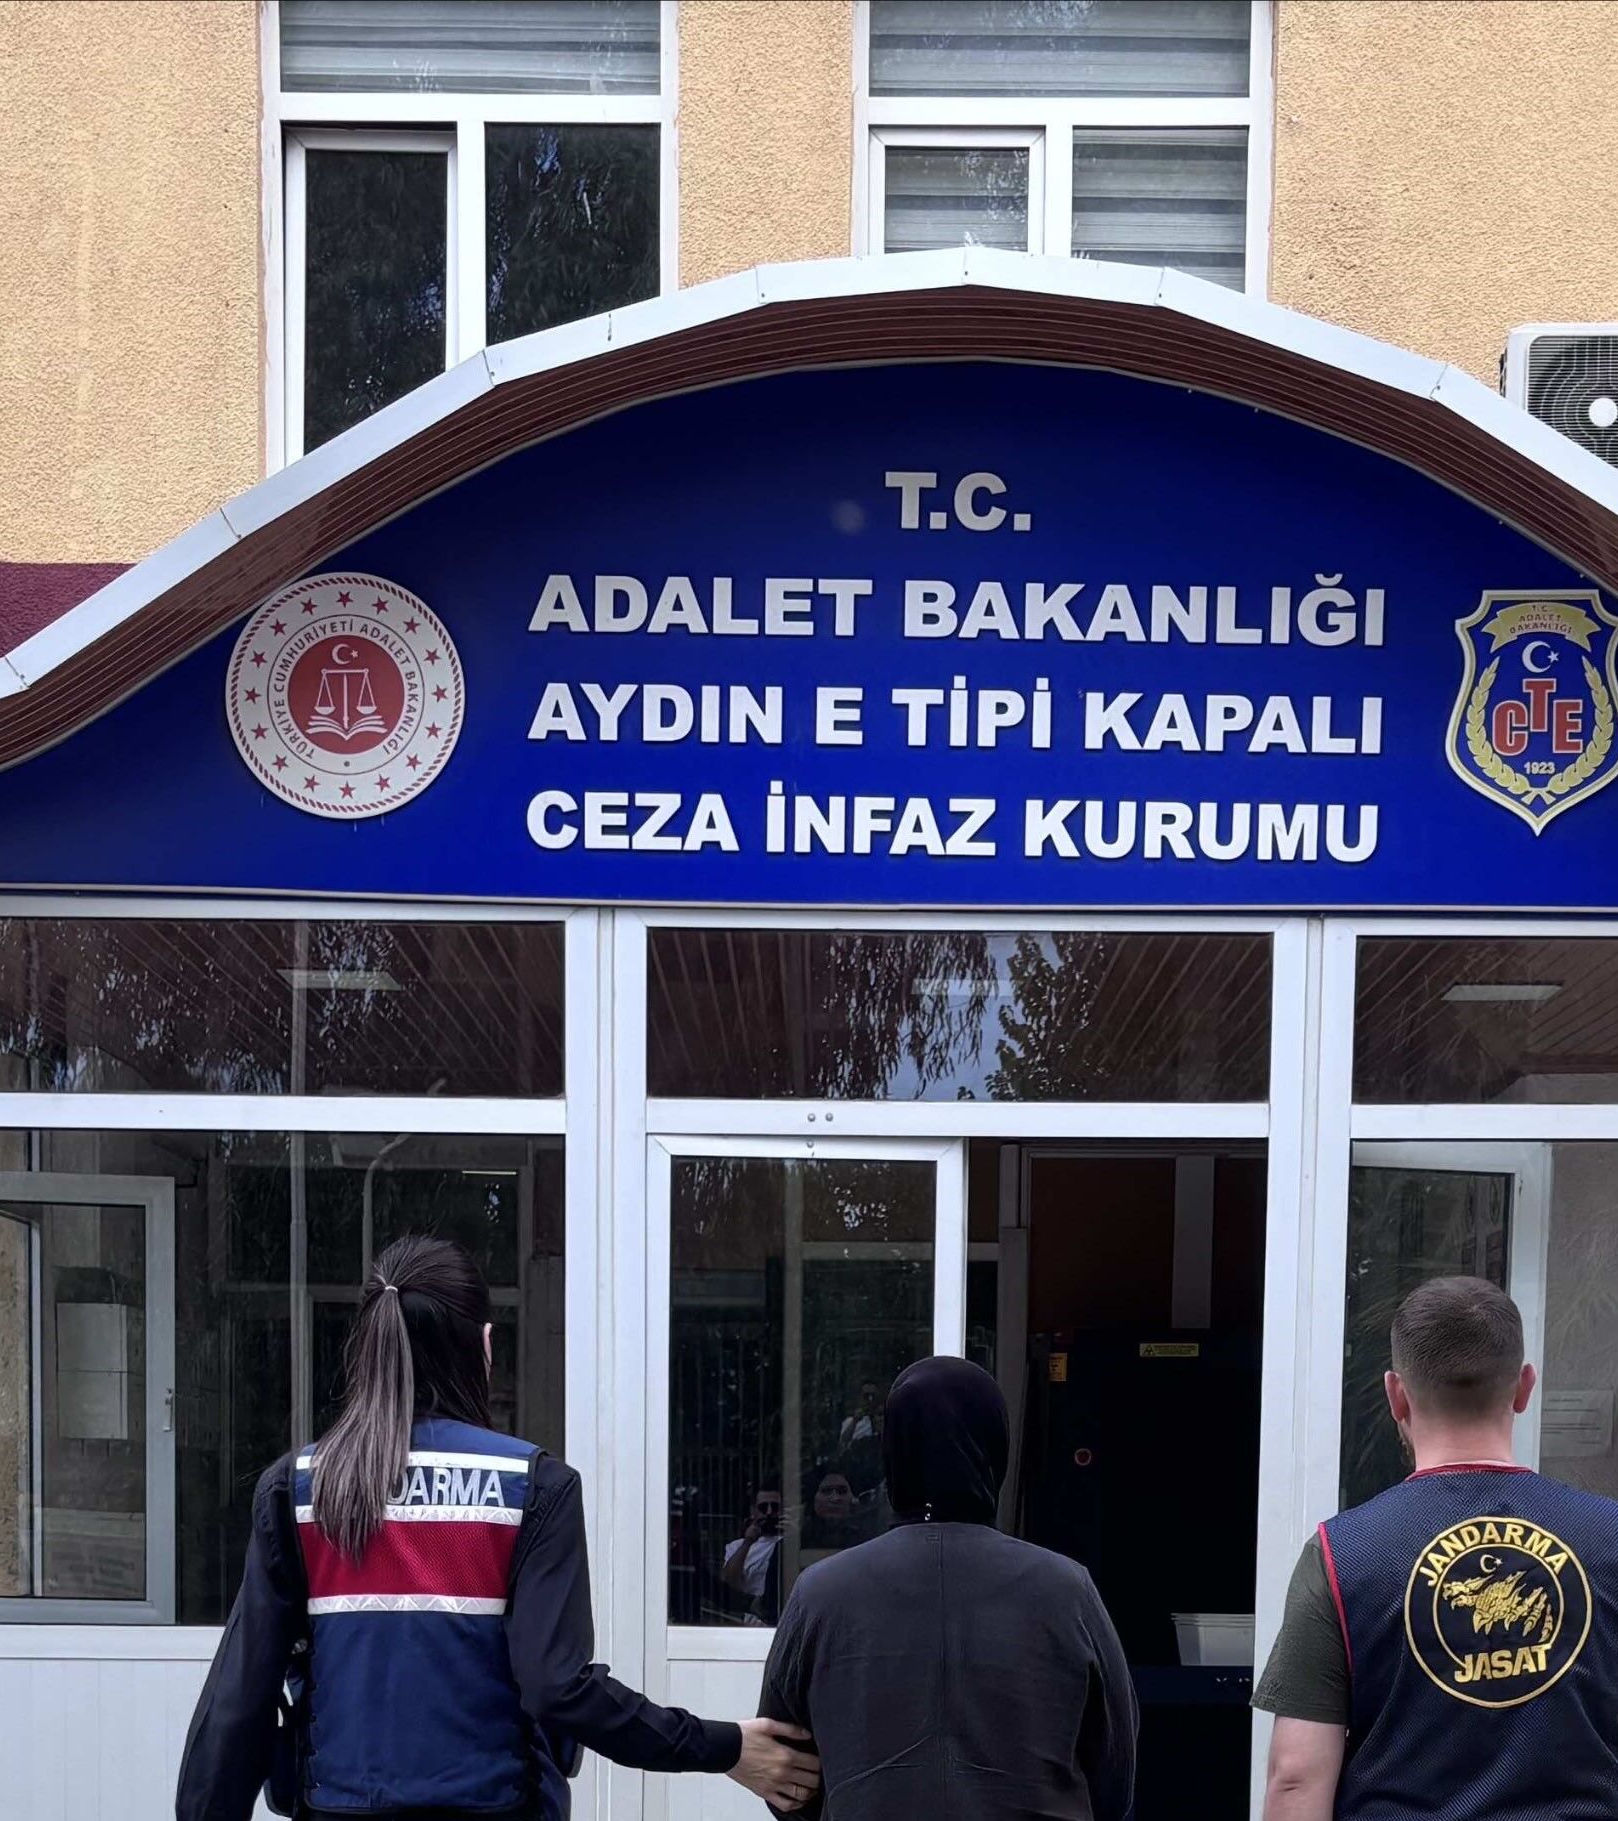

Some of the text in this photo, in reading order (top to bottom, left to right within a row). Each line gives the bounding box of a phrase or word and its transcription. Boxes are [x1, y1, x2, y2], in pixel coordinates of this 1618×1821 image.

[885, 471, 1032, 531] T.C.
[360, 623, 411, 665] ADALET
[528, 573, 1386, 647] ADALET BAKANLIĞI
[274, 618, 354, 693] CUMHURİYETİ
[383, 671, 419, 755] BAKANLIĞI
[527, 675, 1383, 754] AYDIN E TİPİ KAPALI
[1493, 678, 1583, 756] CTE
[1523, 762, 1556, 775] 1923
[526, 780, 1379, 863] CEZA İNFAZ KURUMU
[387, 1466, 506, 1507] DARMA
[1419, 1522, 1569, 1587] JANDARMA
[1454, 1643, 1552, 1683] JASAT
